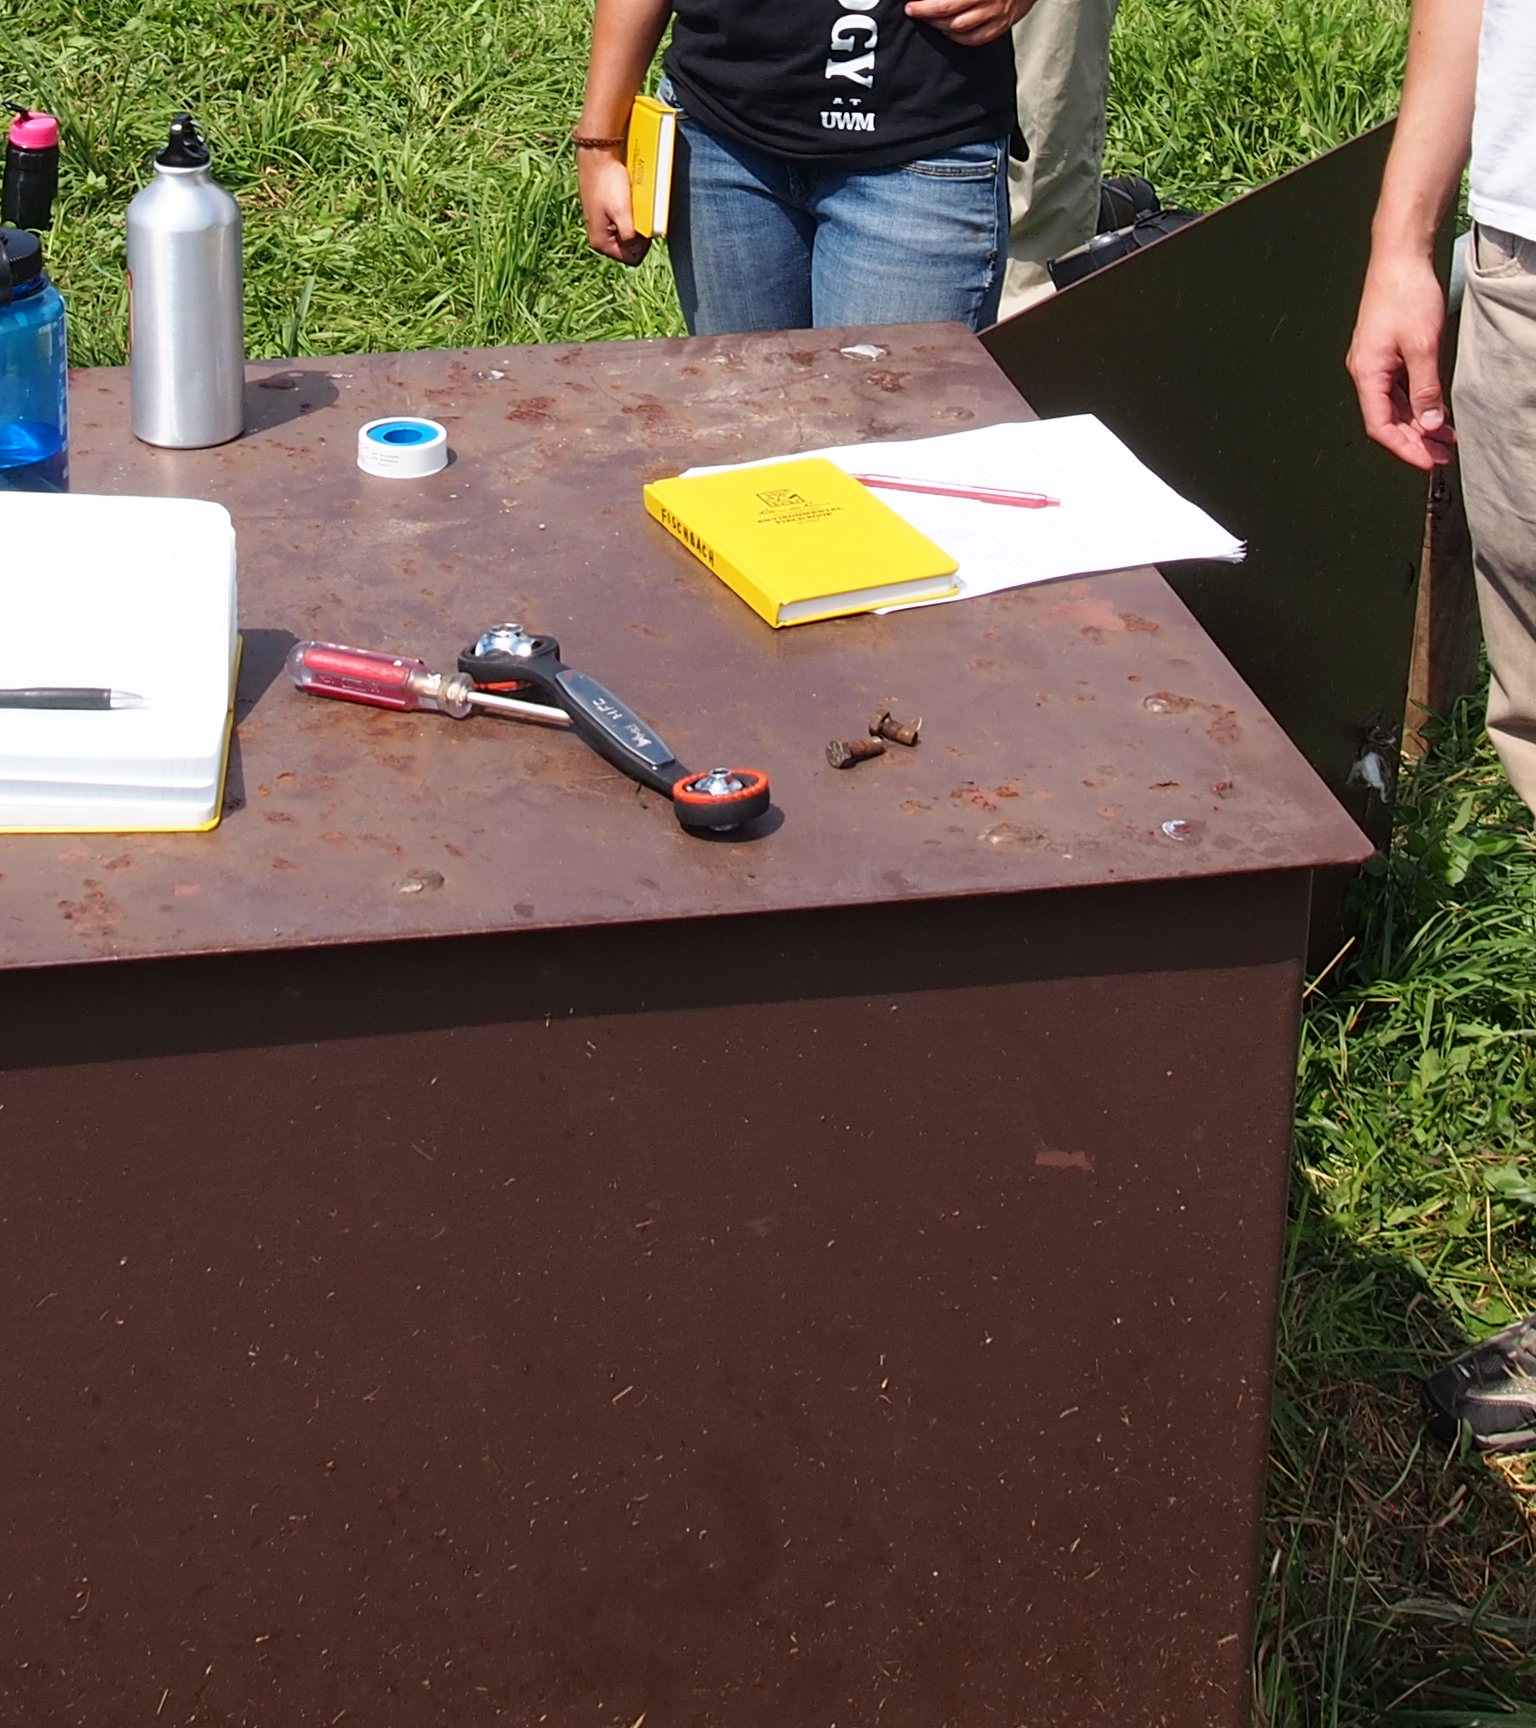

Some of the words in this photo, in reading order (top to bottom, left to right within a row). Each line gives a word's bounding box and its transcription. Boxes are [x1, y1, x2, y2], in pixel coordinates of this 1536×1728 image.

[831, 97, 862, 106] AT
[820, 111, 875, 132] UWM
[660, 508, 715, 568] FISCHBACH
